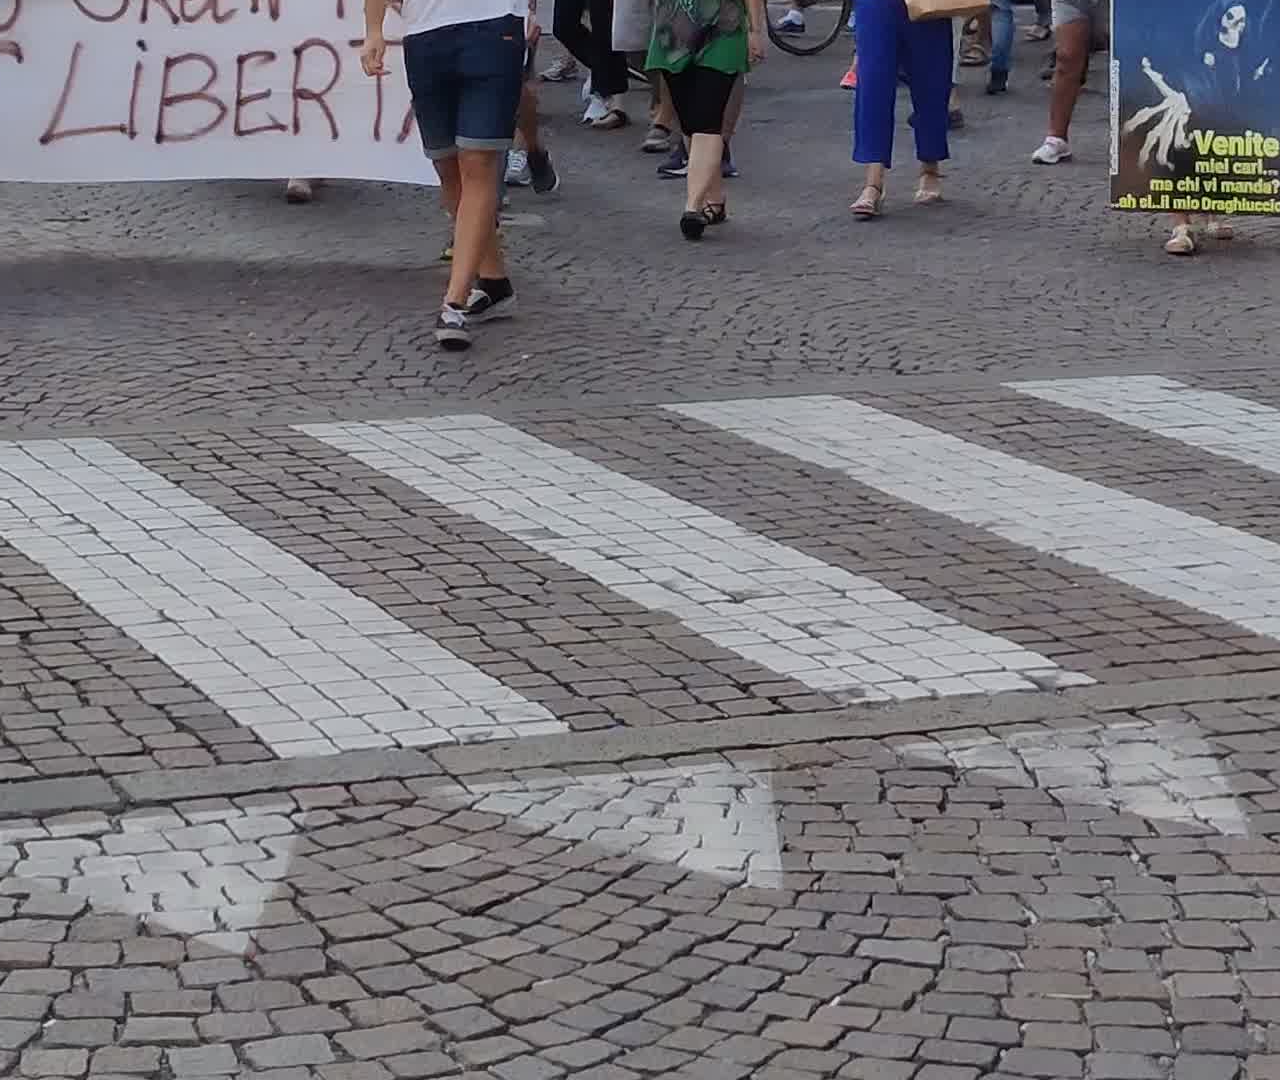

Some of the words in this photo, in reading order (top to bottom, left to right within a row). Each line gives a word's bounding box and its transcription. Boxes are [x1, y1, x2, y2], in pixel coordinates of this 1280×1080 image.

[1193, 129, 1280, 158] Venite
[1195, 158, 1230, 174] miei
[1150, 178, 1173, 191] ma
[1177, 176, 1200, 192] chi
[1203, 177, 1217, 192] vi
[1221, 179, 1280, 194] manda?
[1173, 196, 1200, 210] mio
